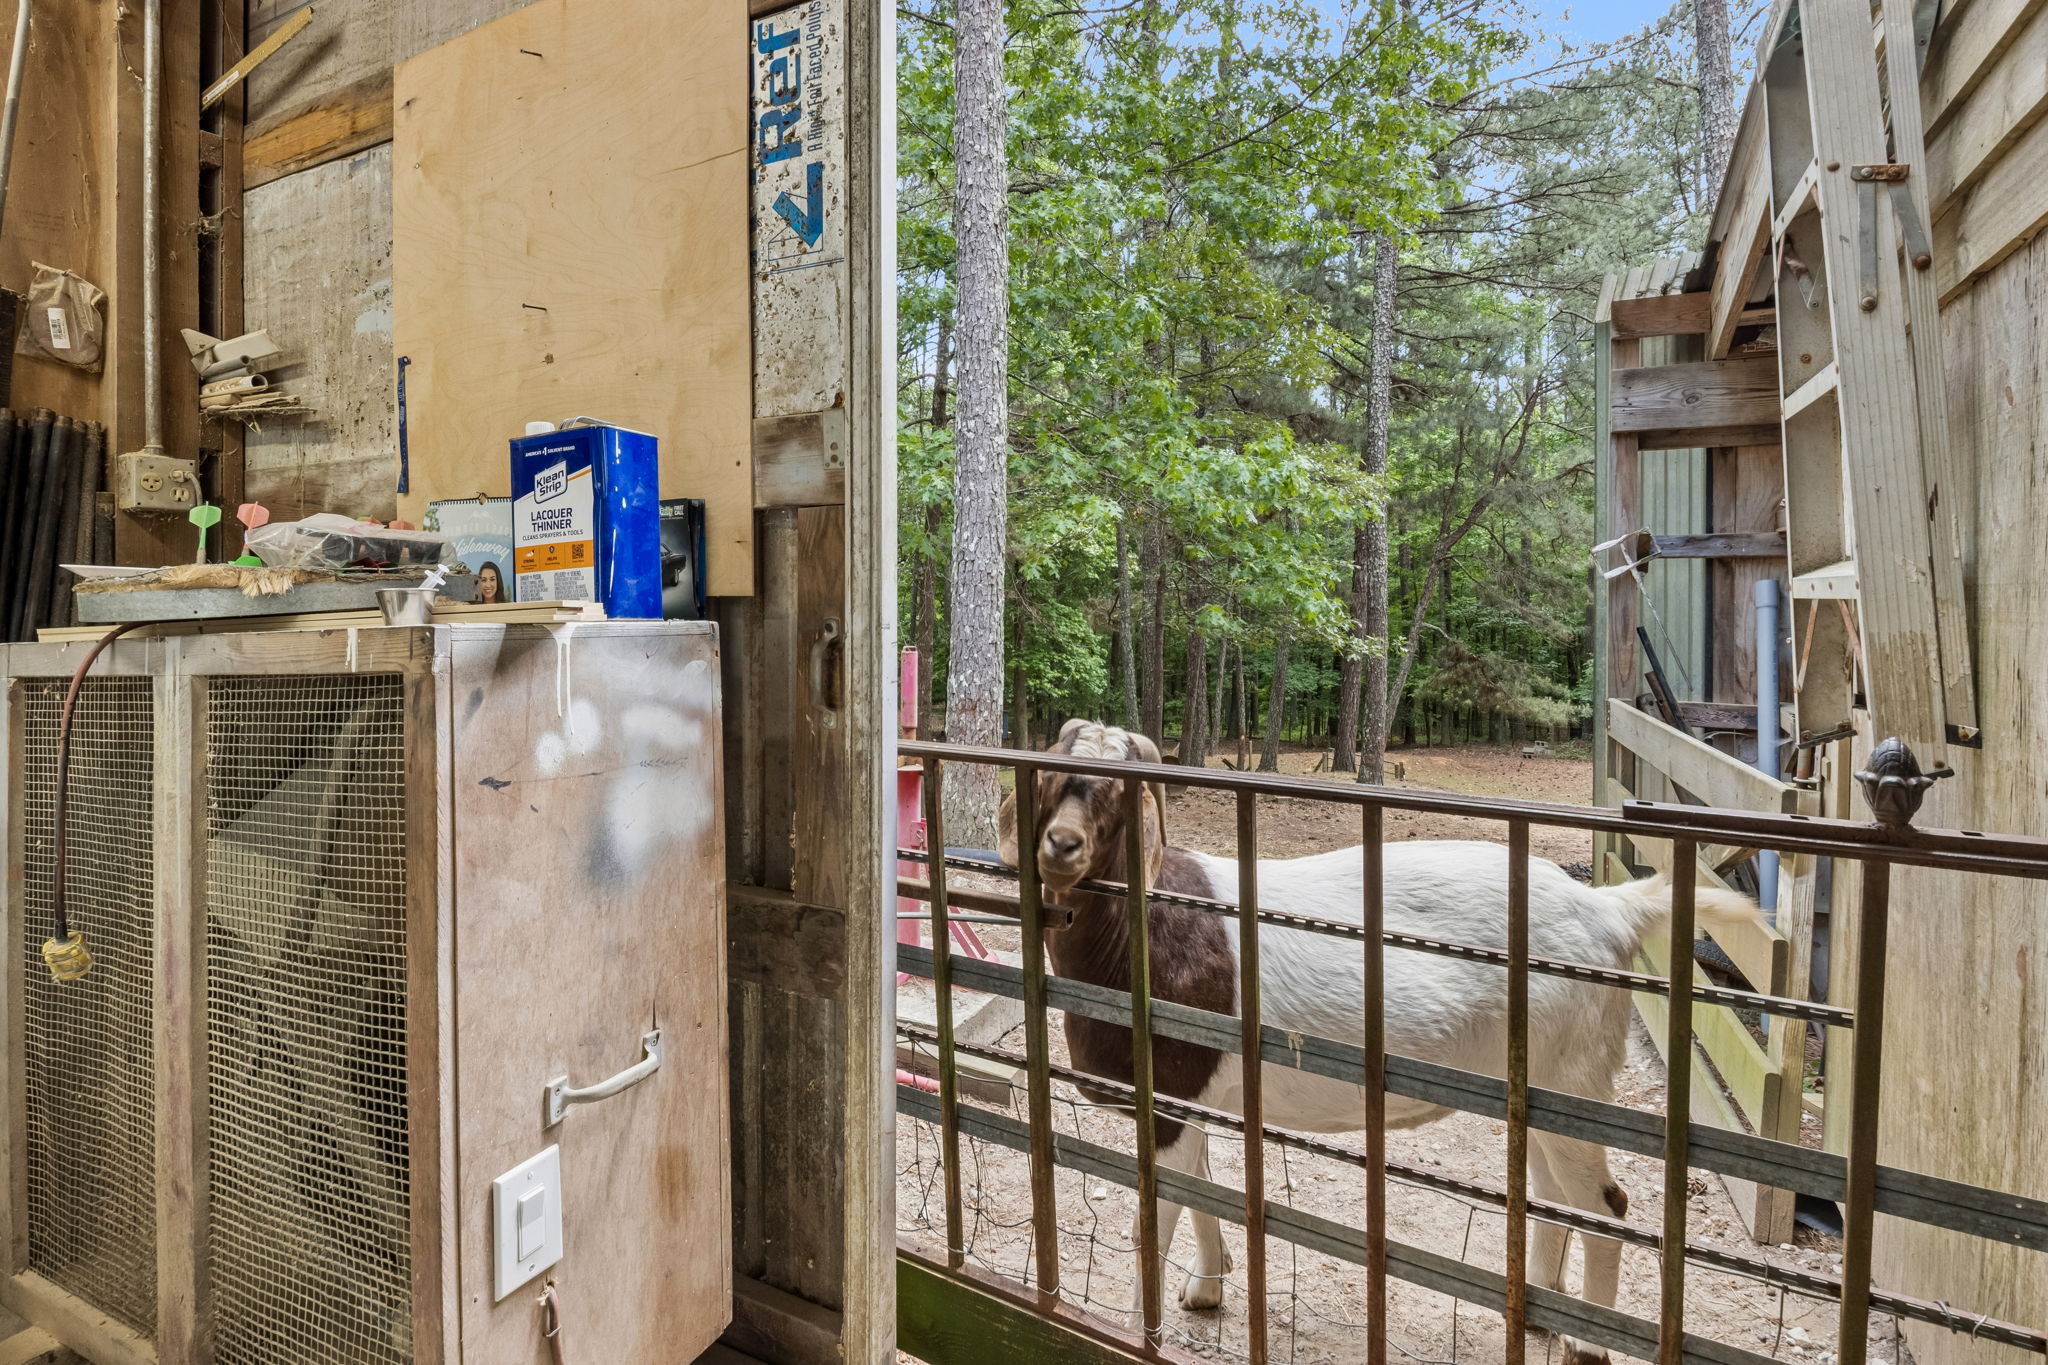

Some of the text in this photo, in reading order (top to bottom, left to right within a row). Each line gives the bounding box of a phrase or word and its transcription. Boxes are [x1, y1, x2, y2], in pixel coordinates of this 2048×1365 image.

[806, 44, 823, 81] Faced
[807, 143, 823, 152] A
[536, 469, 564, 488] Klean
[540, 481, 561, 496] Strip
[531, 507, 572, 521] LACQUER
[532, 519, 572, 532] THINNER
[539, 531, 562, 539] SPRAYERS
